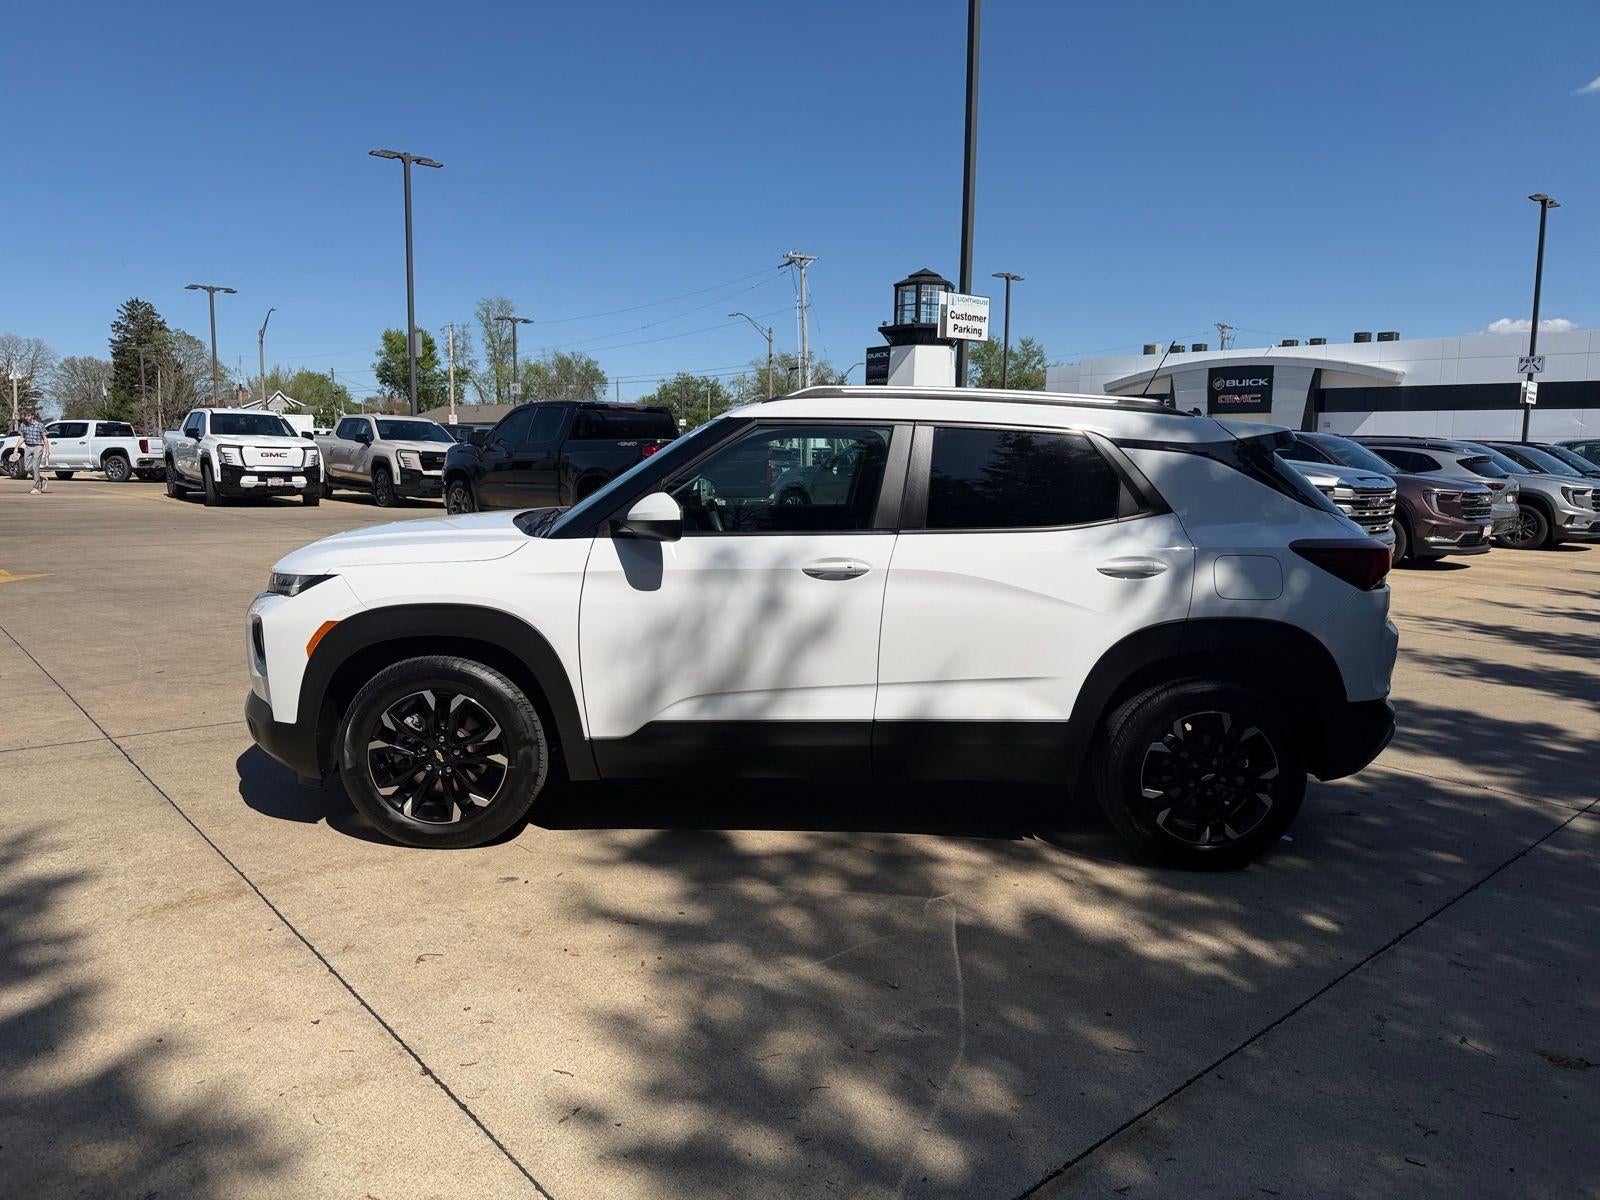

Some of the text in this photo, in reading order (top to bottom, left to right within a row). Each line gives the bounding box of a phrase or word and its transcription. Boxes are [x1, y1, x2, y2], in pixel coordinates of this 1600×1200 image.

[957, 296, 989, 306] LIGHTHOUSE
[949, 310, 987, 323] Customer
[953, 323, 983, 338] Parking
[1226, 378, 1269, 387] BUICK
[1218, 394, 1261, 404] GMC
